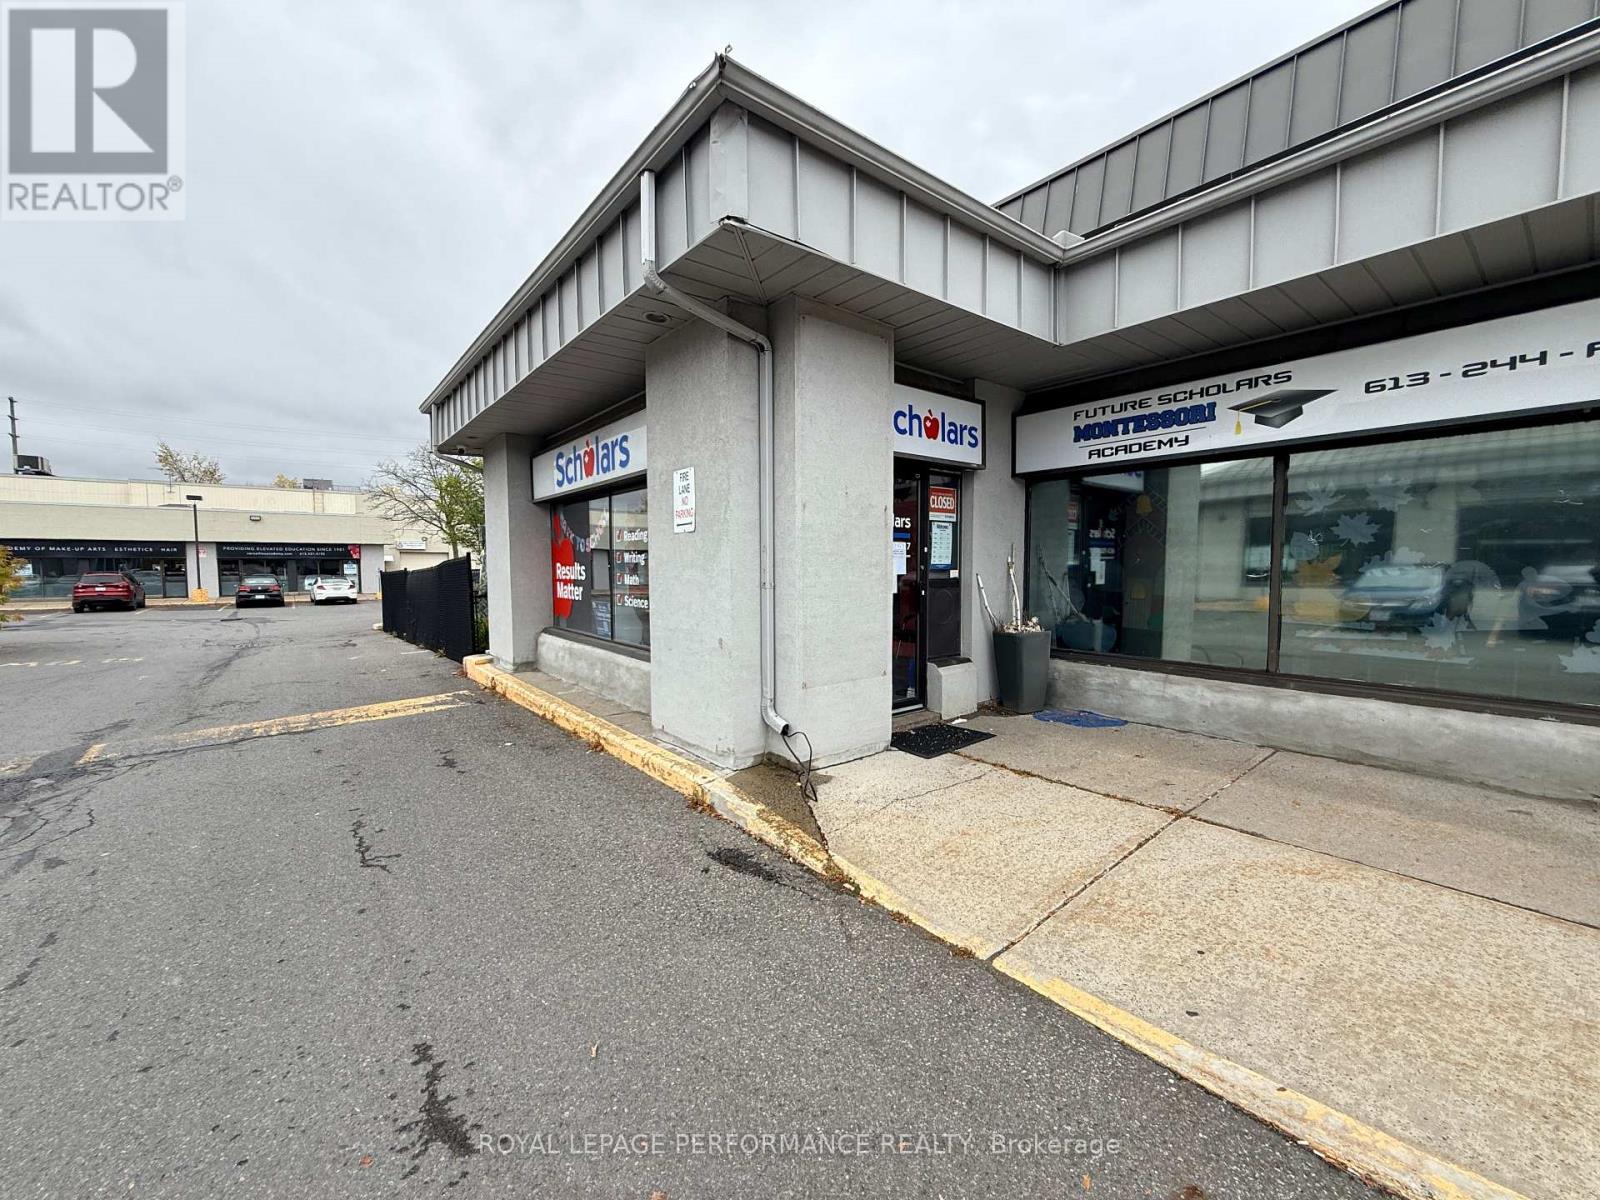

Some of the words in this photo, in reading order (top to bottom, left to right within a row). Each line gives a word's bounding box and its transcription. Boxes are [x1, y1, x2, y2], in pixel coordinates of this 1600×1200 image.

[1073, 396, 1153, 421] FUTURE
[1157, 370, 1292, 406] SCHOLARS
[893, 403, 979, 448] cholars
[1073, 401, 1217, 443] MONTESSORI
[1087, 434, 1190, 460] ACADEMY
[555, 433, 631, 488] Scholars
[679, 470, 690, 482] FIRE
[678, 482, 691, 495] LANE
[930, 495, 955, 510] CLOSED
[675, 507, 694, 519] PARKING
[623, 528, 648, 543] Reading
[623, 551, 646, 566] Writing
[556, 562, 586, 581] Results
[624, 573, 640, 586] Math
[556, 581, 583, 601] Matter
[624, 595, 648, 609] Science
